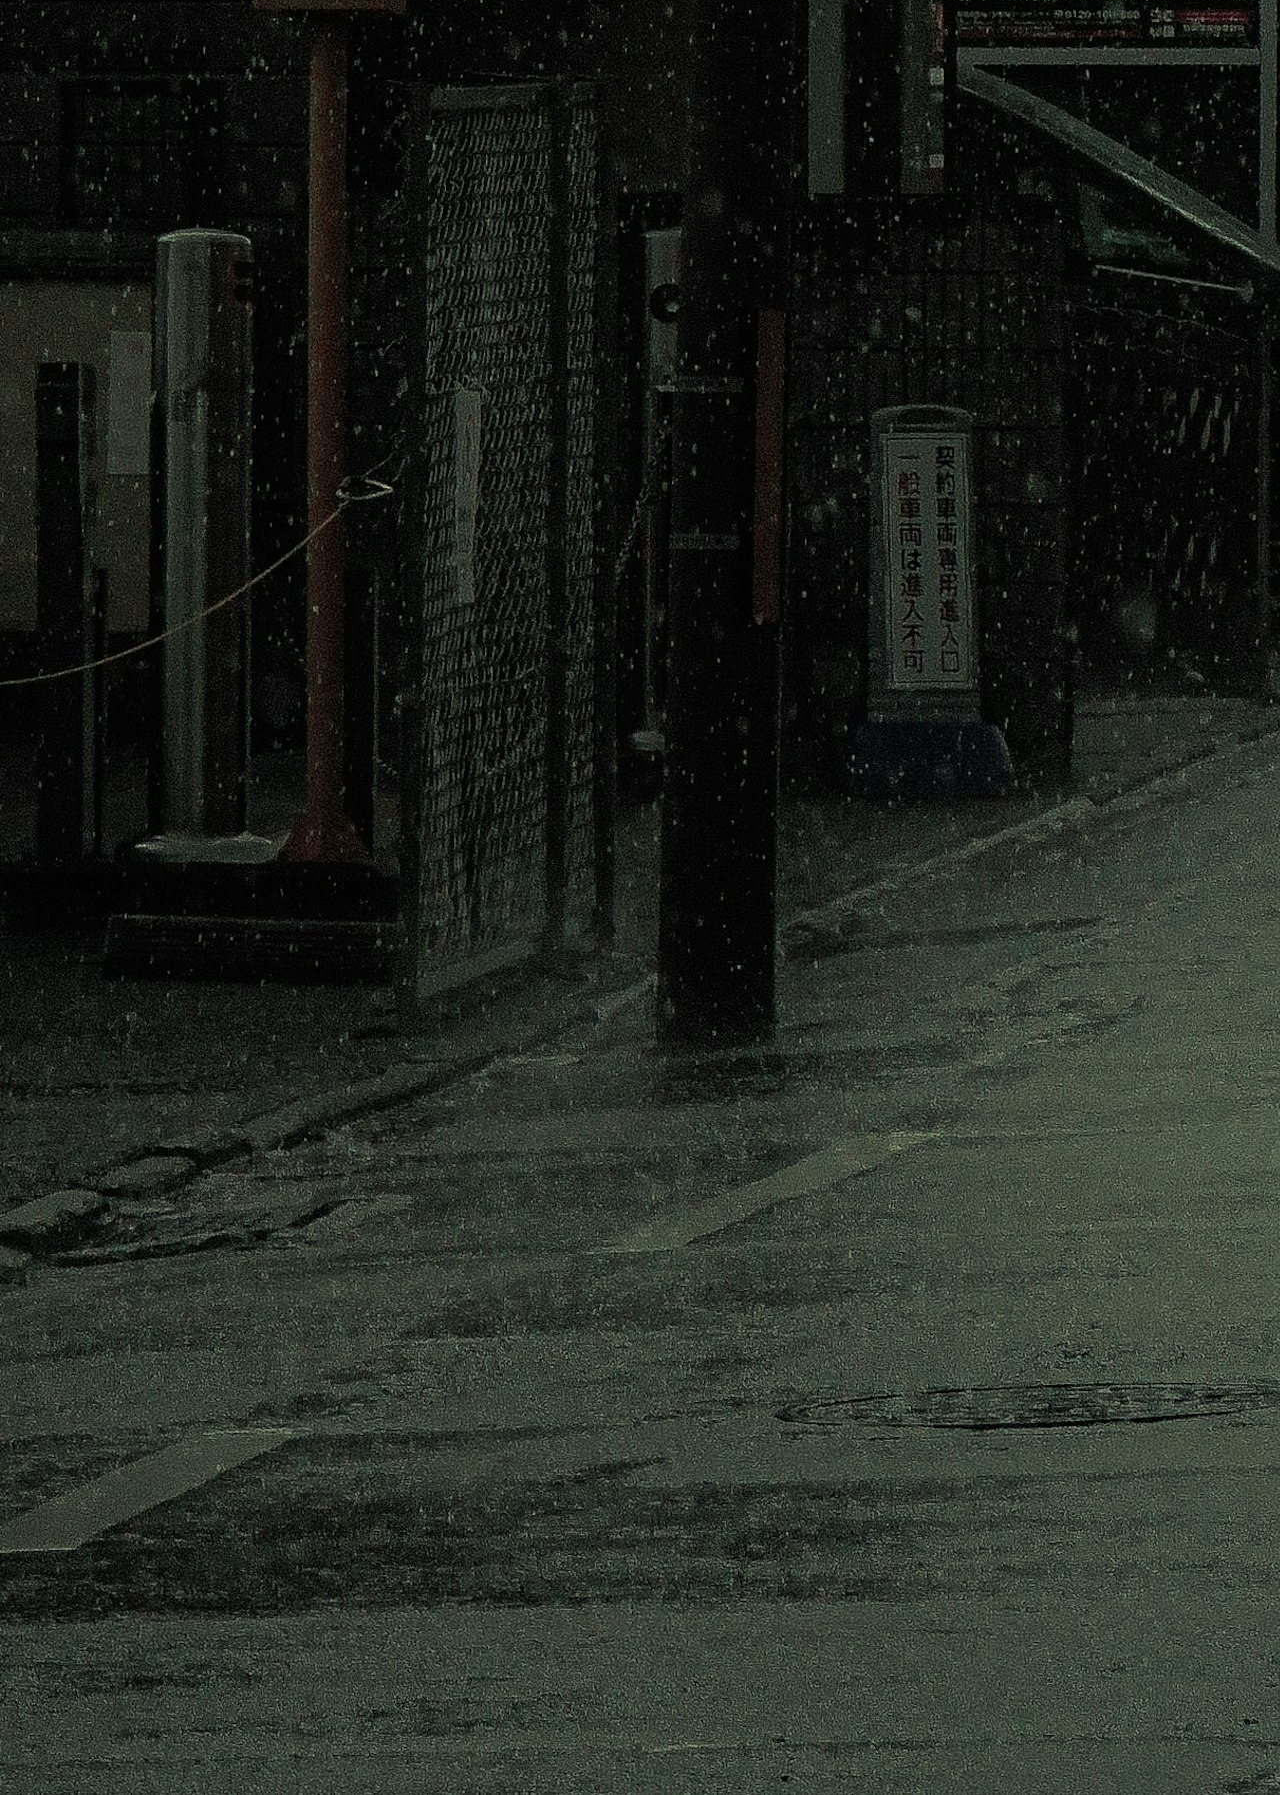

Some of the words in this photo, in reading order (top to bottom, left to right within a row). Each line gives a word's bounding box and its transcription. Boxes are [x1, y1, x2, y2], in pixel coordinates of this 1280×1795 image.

[896, 451, 925, 675] 一般車両は進入不可
